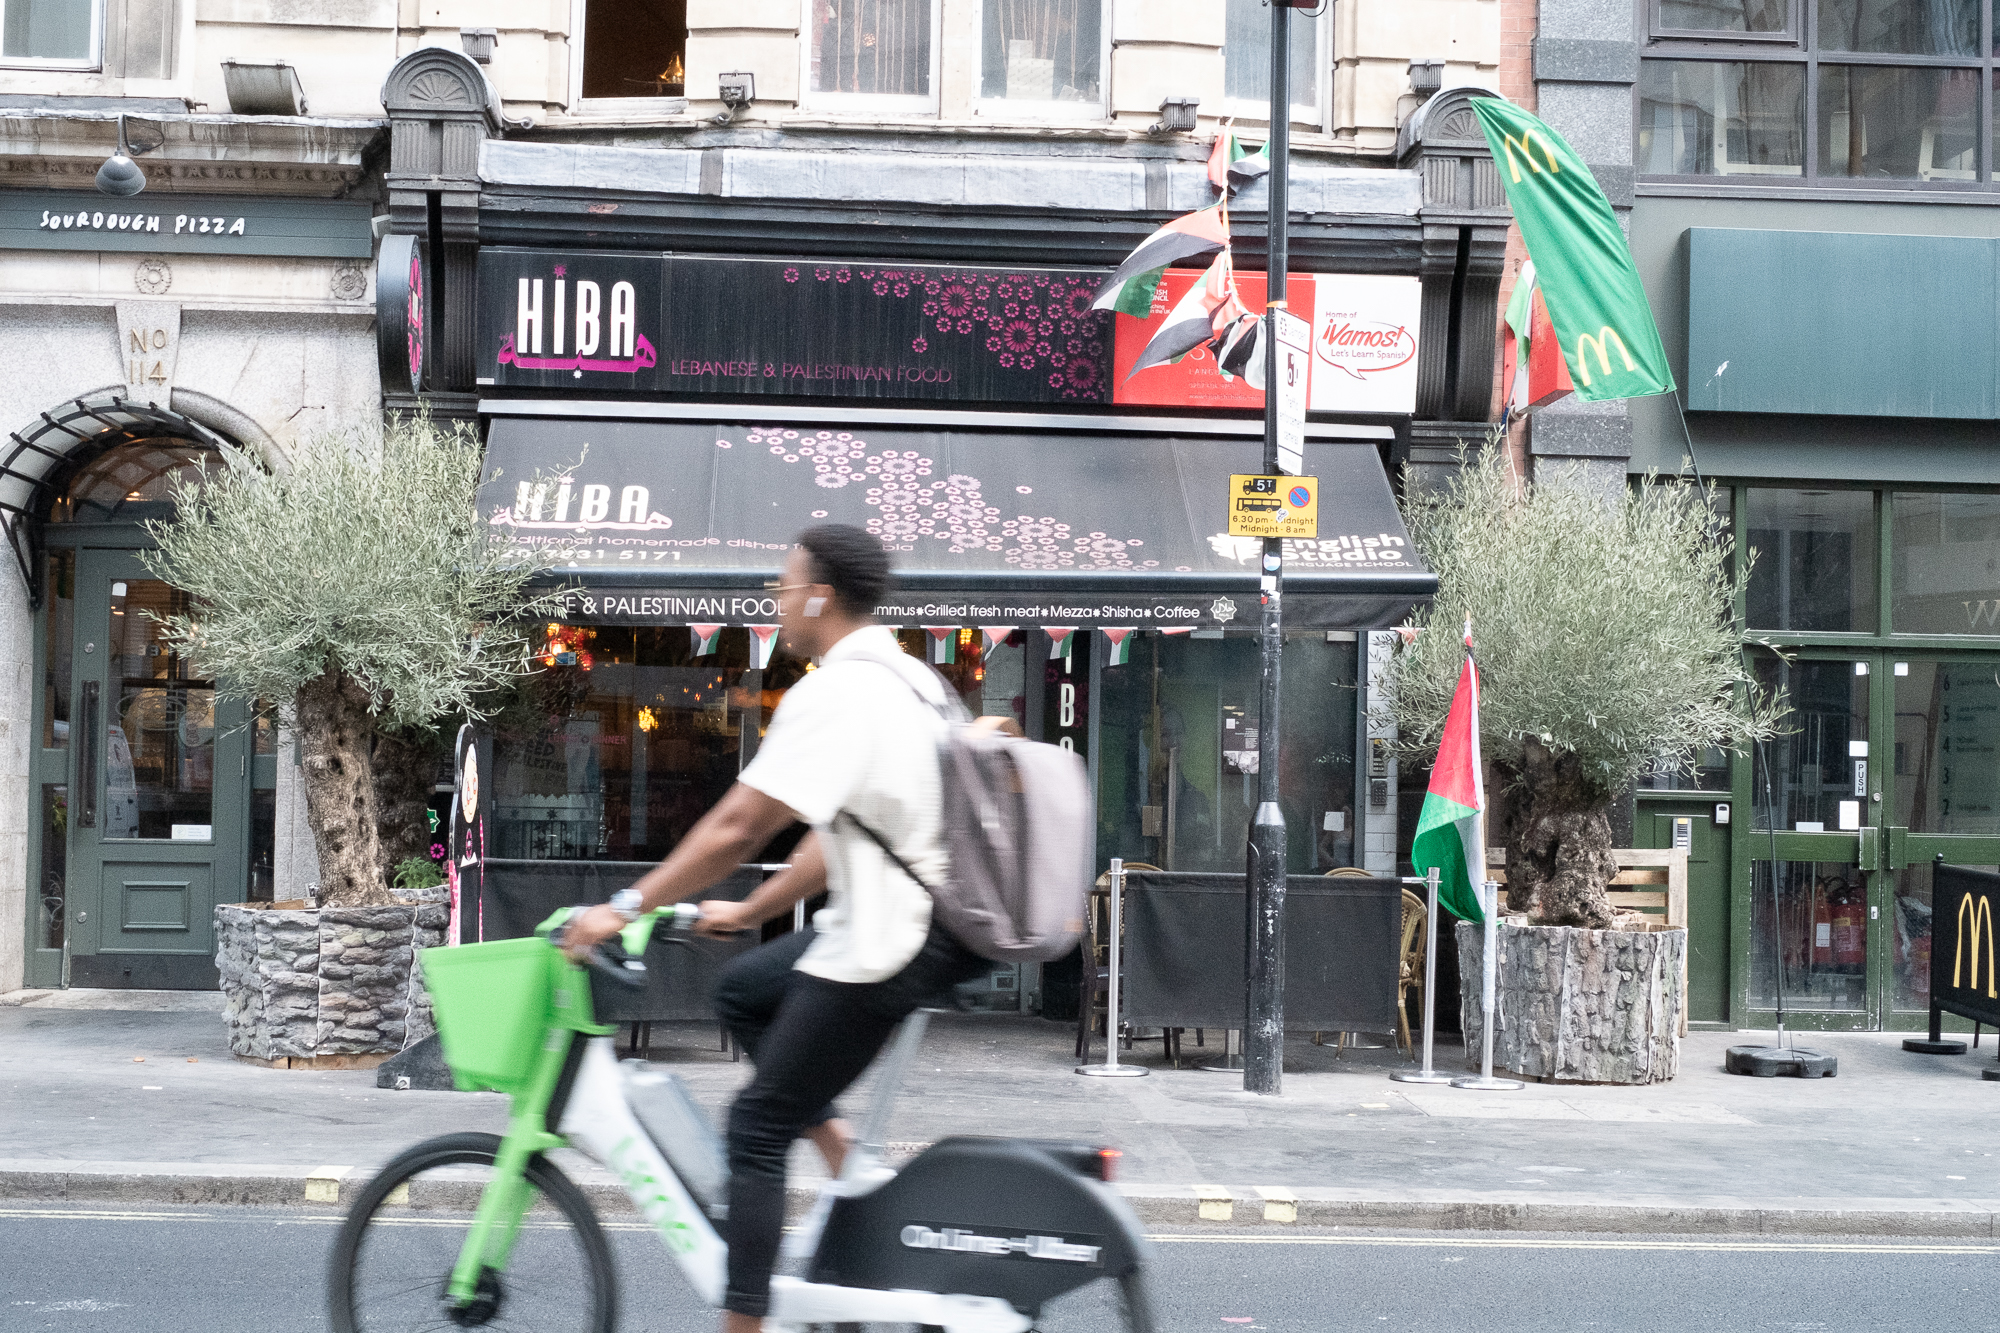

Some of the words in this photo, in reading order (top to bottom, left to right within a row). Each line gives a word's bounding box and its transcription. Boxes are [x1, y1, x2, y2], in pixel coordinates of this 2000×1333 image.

[40, 210, 160, 232] SOURDOUGH
[174, 214, 245, 236] PIZZA
[517, 277, 636, 357] HIBA
[1326, 311, 1348, 319] Home
[1348, 311, 1358, 319] of
[1331, 349, 1349, 357] Let's
[1352, 350, 1375, 358] Learn
[1377, 350, 1407, 360] Spanish
[129, 359, 168, 386] 114
[671, 360, 758, 378] LEBANESE
[762, 362, 777, 378] &
[782, 362, 891, 382] PALESTINIAN
[897, 364, 952, 383] FOOD
[513, 480, 649, 524] HIBA
[1232, 515, 1254, 523] 6.30
[1255, 517, 1269, 525] pm
[1275, 517, 1314, 526] idnight
[1240, 525, 1279, 534] Midnight
[598, 535, 720, 547] homemade
[727, 538, 788, 550] dishes
[618, 550, 682, 561] 5171
[1282, 547, 1402, 562] Studio
[582, 597, 598, 615] &
[603, 596, 724, 616] PALESTINIAN
[870, 605, 916, 617] ummus
[924, 604, 967, 618] Grilled
[969, 604, 1001, 618] fresh
[1004, 606, 1041, 618] meat
[1050, 605, 1092, 618] Mezza
[1102, 605, 1143, 618] Shisha
[1154, 606, 1200, 619] Coffee
